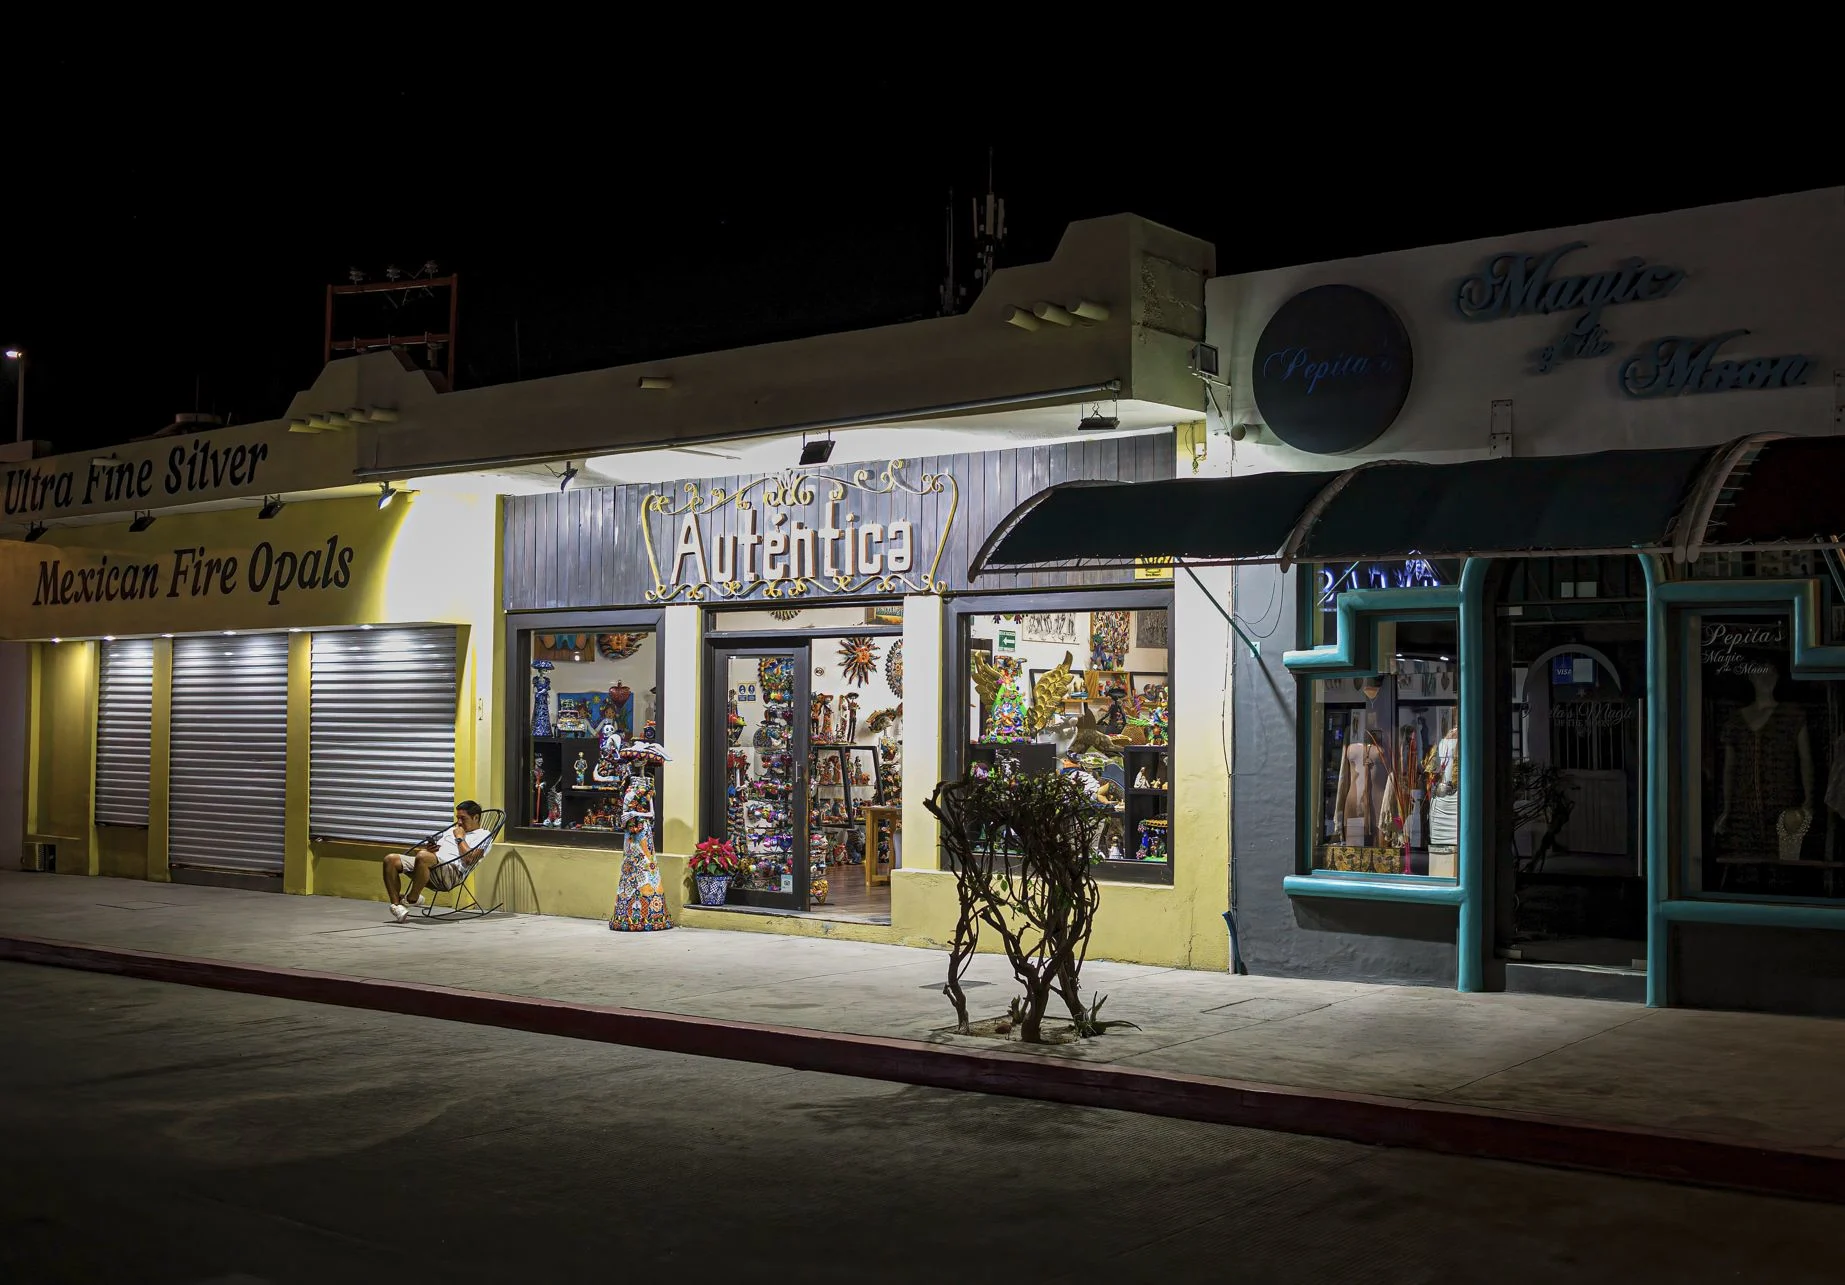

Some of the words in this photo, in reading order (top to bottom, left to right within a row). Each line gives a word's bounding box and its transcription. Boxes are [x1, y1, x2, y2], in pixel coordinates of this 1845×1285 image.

[1456, 240, 1686, 332] Magic
[1622, 328, 1816, 398] Moon
[5, 467, 74, 515] Ultra
[82, 452, 153, 505] Fine
[165, 439, 268, 494] Silver
[32, 556, 159, 606] Mexican
[166, 546, 238, 598] Fire
[249, 535, 354, 606] Opals
[670, 501, 914, 585] Auténtica
[1701, 619, 1787, 654] Pepita's
[1701, 649, 1745, 667] Magic
[1733, 662, 1769, 676] Moon
